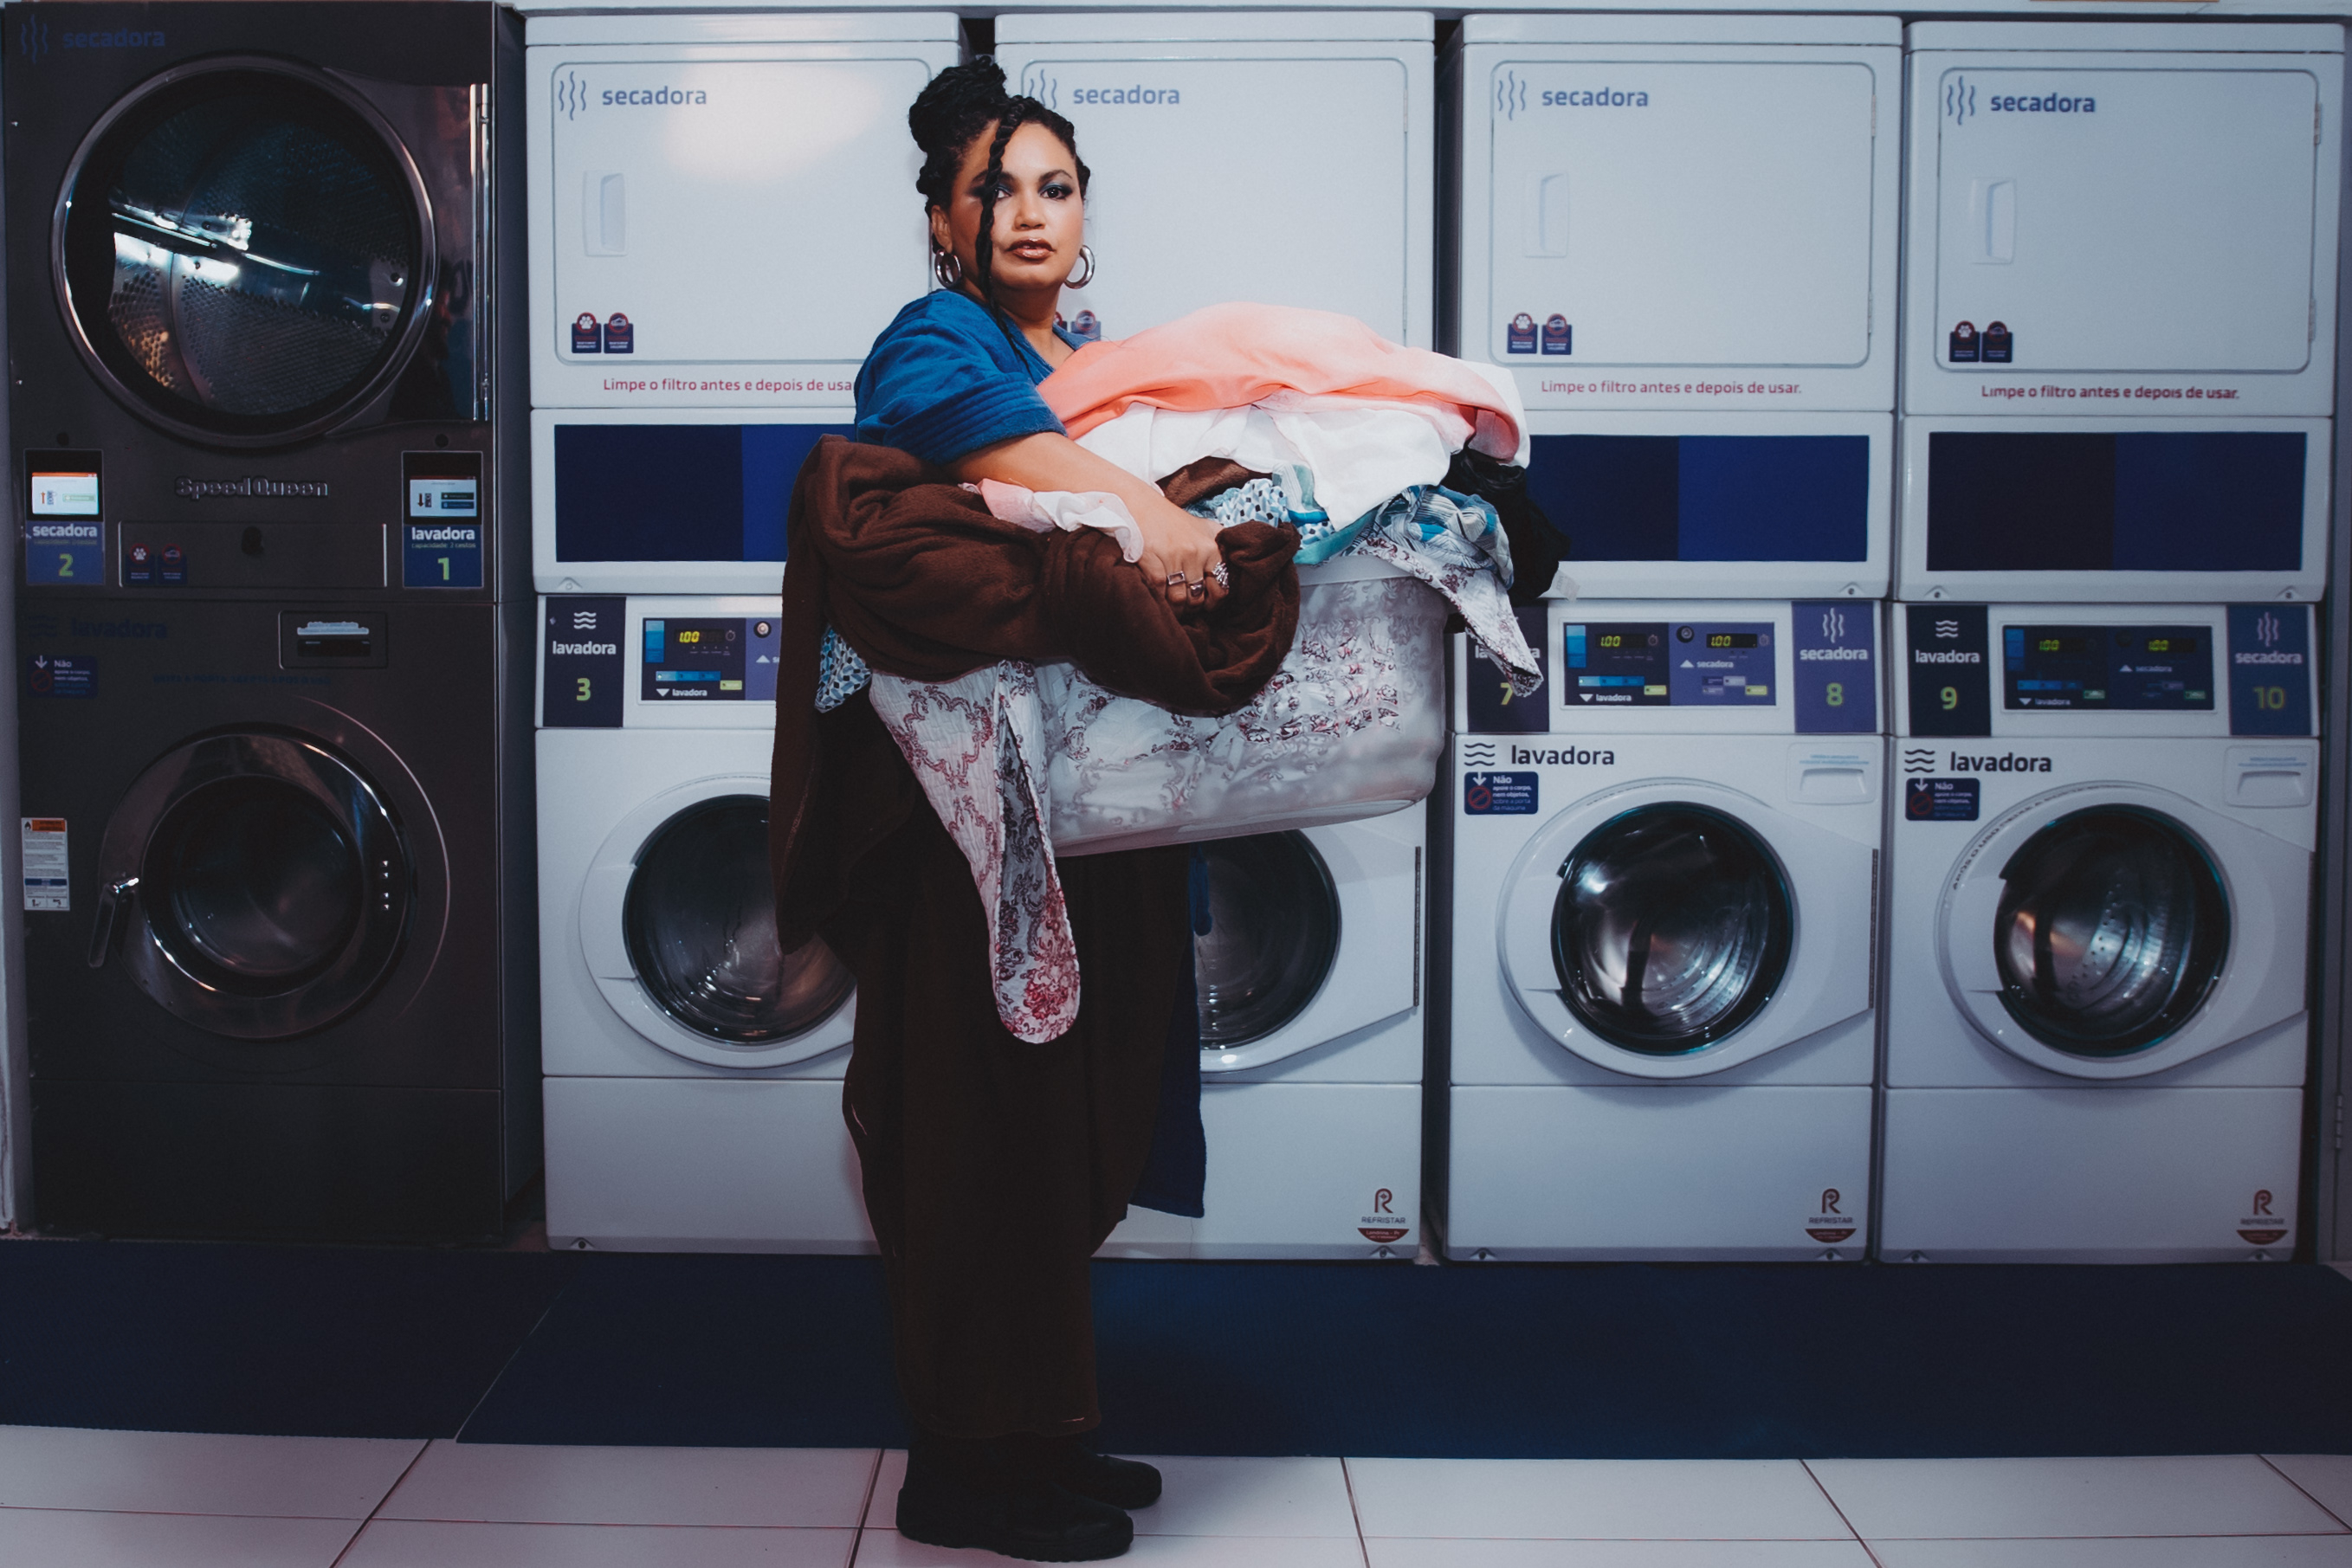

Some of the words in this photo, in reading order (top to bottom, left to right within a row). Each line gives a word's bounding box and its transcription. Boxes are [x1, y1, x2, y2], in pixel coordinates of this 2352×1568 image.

[63, 28, 165, 48] secadora
[602, 85, 708, 106] secadora
[1073, 85, 1180, 105] secadora
[1541, 87, 1649, 107] secadora
[1991, 93, 2096, 113] secadora
[604, 377, 646, 393] Limpe
[649, 381, 659, 391] o
[662, 377, 697, 391] filtro
[701, 379, 740, 391] antes
[745, 381, 753, 391] e
[756, 378, 804, 394] depois
[807, 378, 824, 391] de
[1541, 381, 1585, 396] Limpe
[1588, 384, 1597, 394] o
[1600, 380, 1637, 394] filtro
[1640, 382, 1681, 394] antes
[1684, 384, 1693, 394] e
[1696, 381, 1744, 397] depois
[1748, 381, 1765, 394] de
[1768, 384, 1802, 395] usar.
[1981, 385, 2026, 400] Limpe
[2028, 388, 2038, 398] o
[2040, 384, 2077, 398] filtro
[2080, 386, 2121, 398] antes
[2123, 388, 2132, 398] e
[2135, 385, 2183, 401] depois
[2186, 386, 2204, 399] de
[2207, 388, 2239, 399] usar.
[175, 477, 250, 500] Speed
[251, 477, 329, 497] Queen
[32, 522, 97, 537] secadora
[411, 526, 475, 540] lavadora
[58, 553, 74, 577] 2
[437, 557, 449, 580] 1
[71, 617, 168, 639] lavadora
[552, 641, 617, 655] lavadora
[1800, 646, 1868, 661] secadora
[1915, 649, 1980, 663] lavadora
[2235, 650, 2303, 664] secadora
[1696, 660, 1735, 668] secadora
[576, 677, 591, 701] 3
[672, 688, 708, 697] lavadora
[1500, 682, 1513, 706] 7
[1595, 694, 1632, 702] lavadora
[1826, 683, 1844, 707] 8
[1941, 686, 1958, 710] 9
[2254, 687, 2285, 710] 10
[2034, 698, 2071, 707] lavadora
[1511, 745, 1615, 765] lavadora
[1950, 752, 2052, 773] lavadora
[1492, 775, 1513, 784] Não
[1935, 782, 1954, 790] Não
